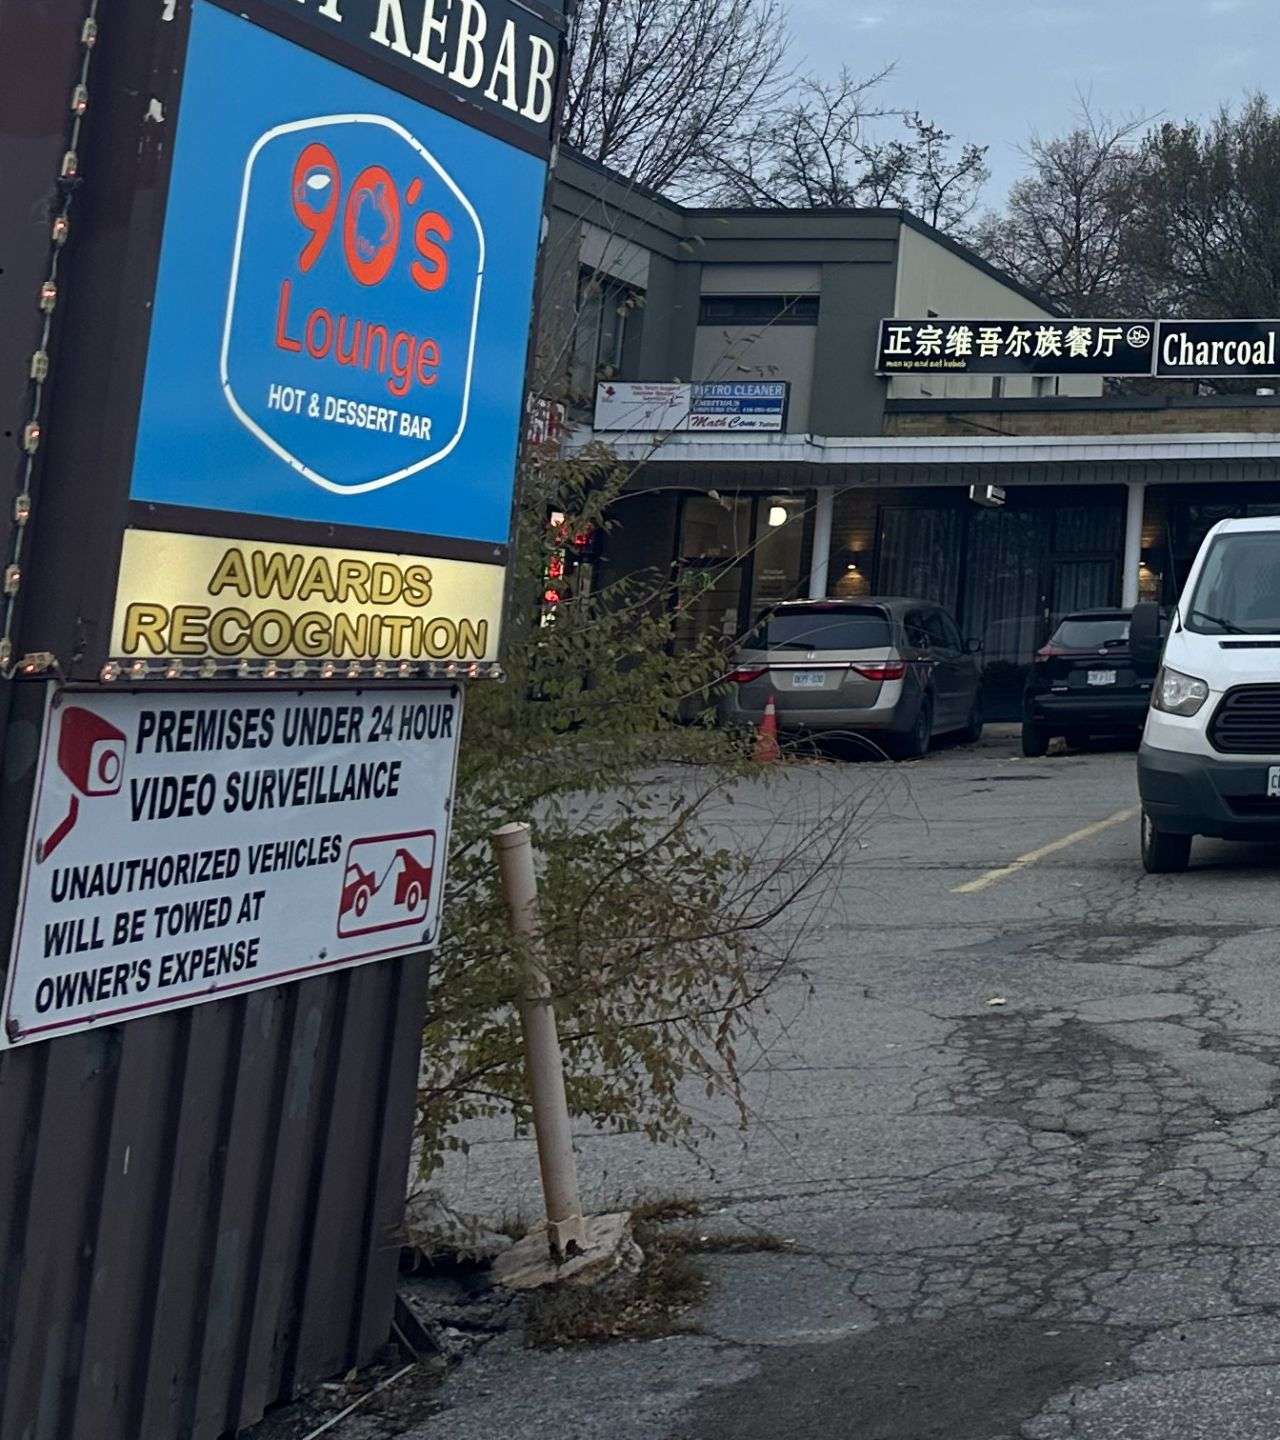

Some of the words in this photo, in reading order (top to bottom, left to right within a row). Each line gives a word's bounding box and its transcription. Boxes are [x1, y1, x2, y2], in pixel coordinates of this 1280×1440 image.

[292, 141, 453, 292] 90's
[274, 277, 440, 397] Lounge
[883, 324, 1123, 358] 正宗维吾尔族餐厅
[1163, 331, 1276, 366] Charcoal
[268, 383, 307, 417] HOT
[308, 394, 320, 418] &
[324, 396, 399, 433] DESSERT
[400, 411, 432, 441] BAR
[208, 548, 433, 606] AWARDS
[123, 602, 488, 659] RECOGNITION
[136, 708, 274, 754] PREMISES
[282, 706, 364, 747] UNDER
[369, 704, 394, 742] 24
[399, 704, 455, 741] HOUR
[130, 775, 217, 821] VIDEO
[223, 761, 402, 813] SURVEILLANCE
[51, 852, 240, 903] UNAUTHORIZED
[248, 834, 342, 872] VEHICLES
[44, 916, 104, 958] WILL
[112, 909, 147, 946] BE
[155, 895, 232, 937] TOWED
[238, 890, 266, 922] AT
[35, 960, 151, 1013] OWNER'S
[157, 937, 261, 988] EXPENSE
